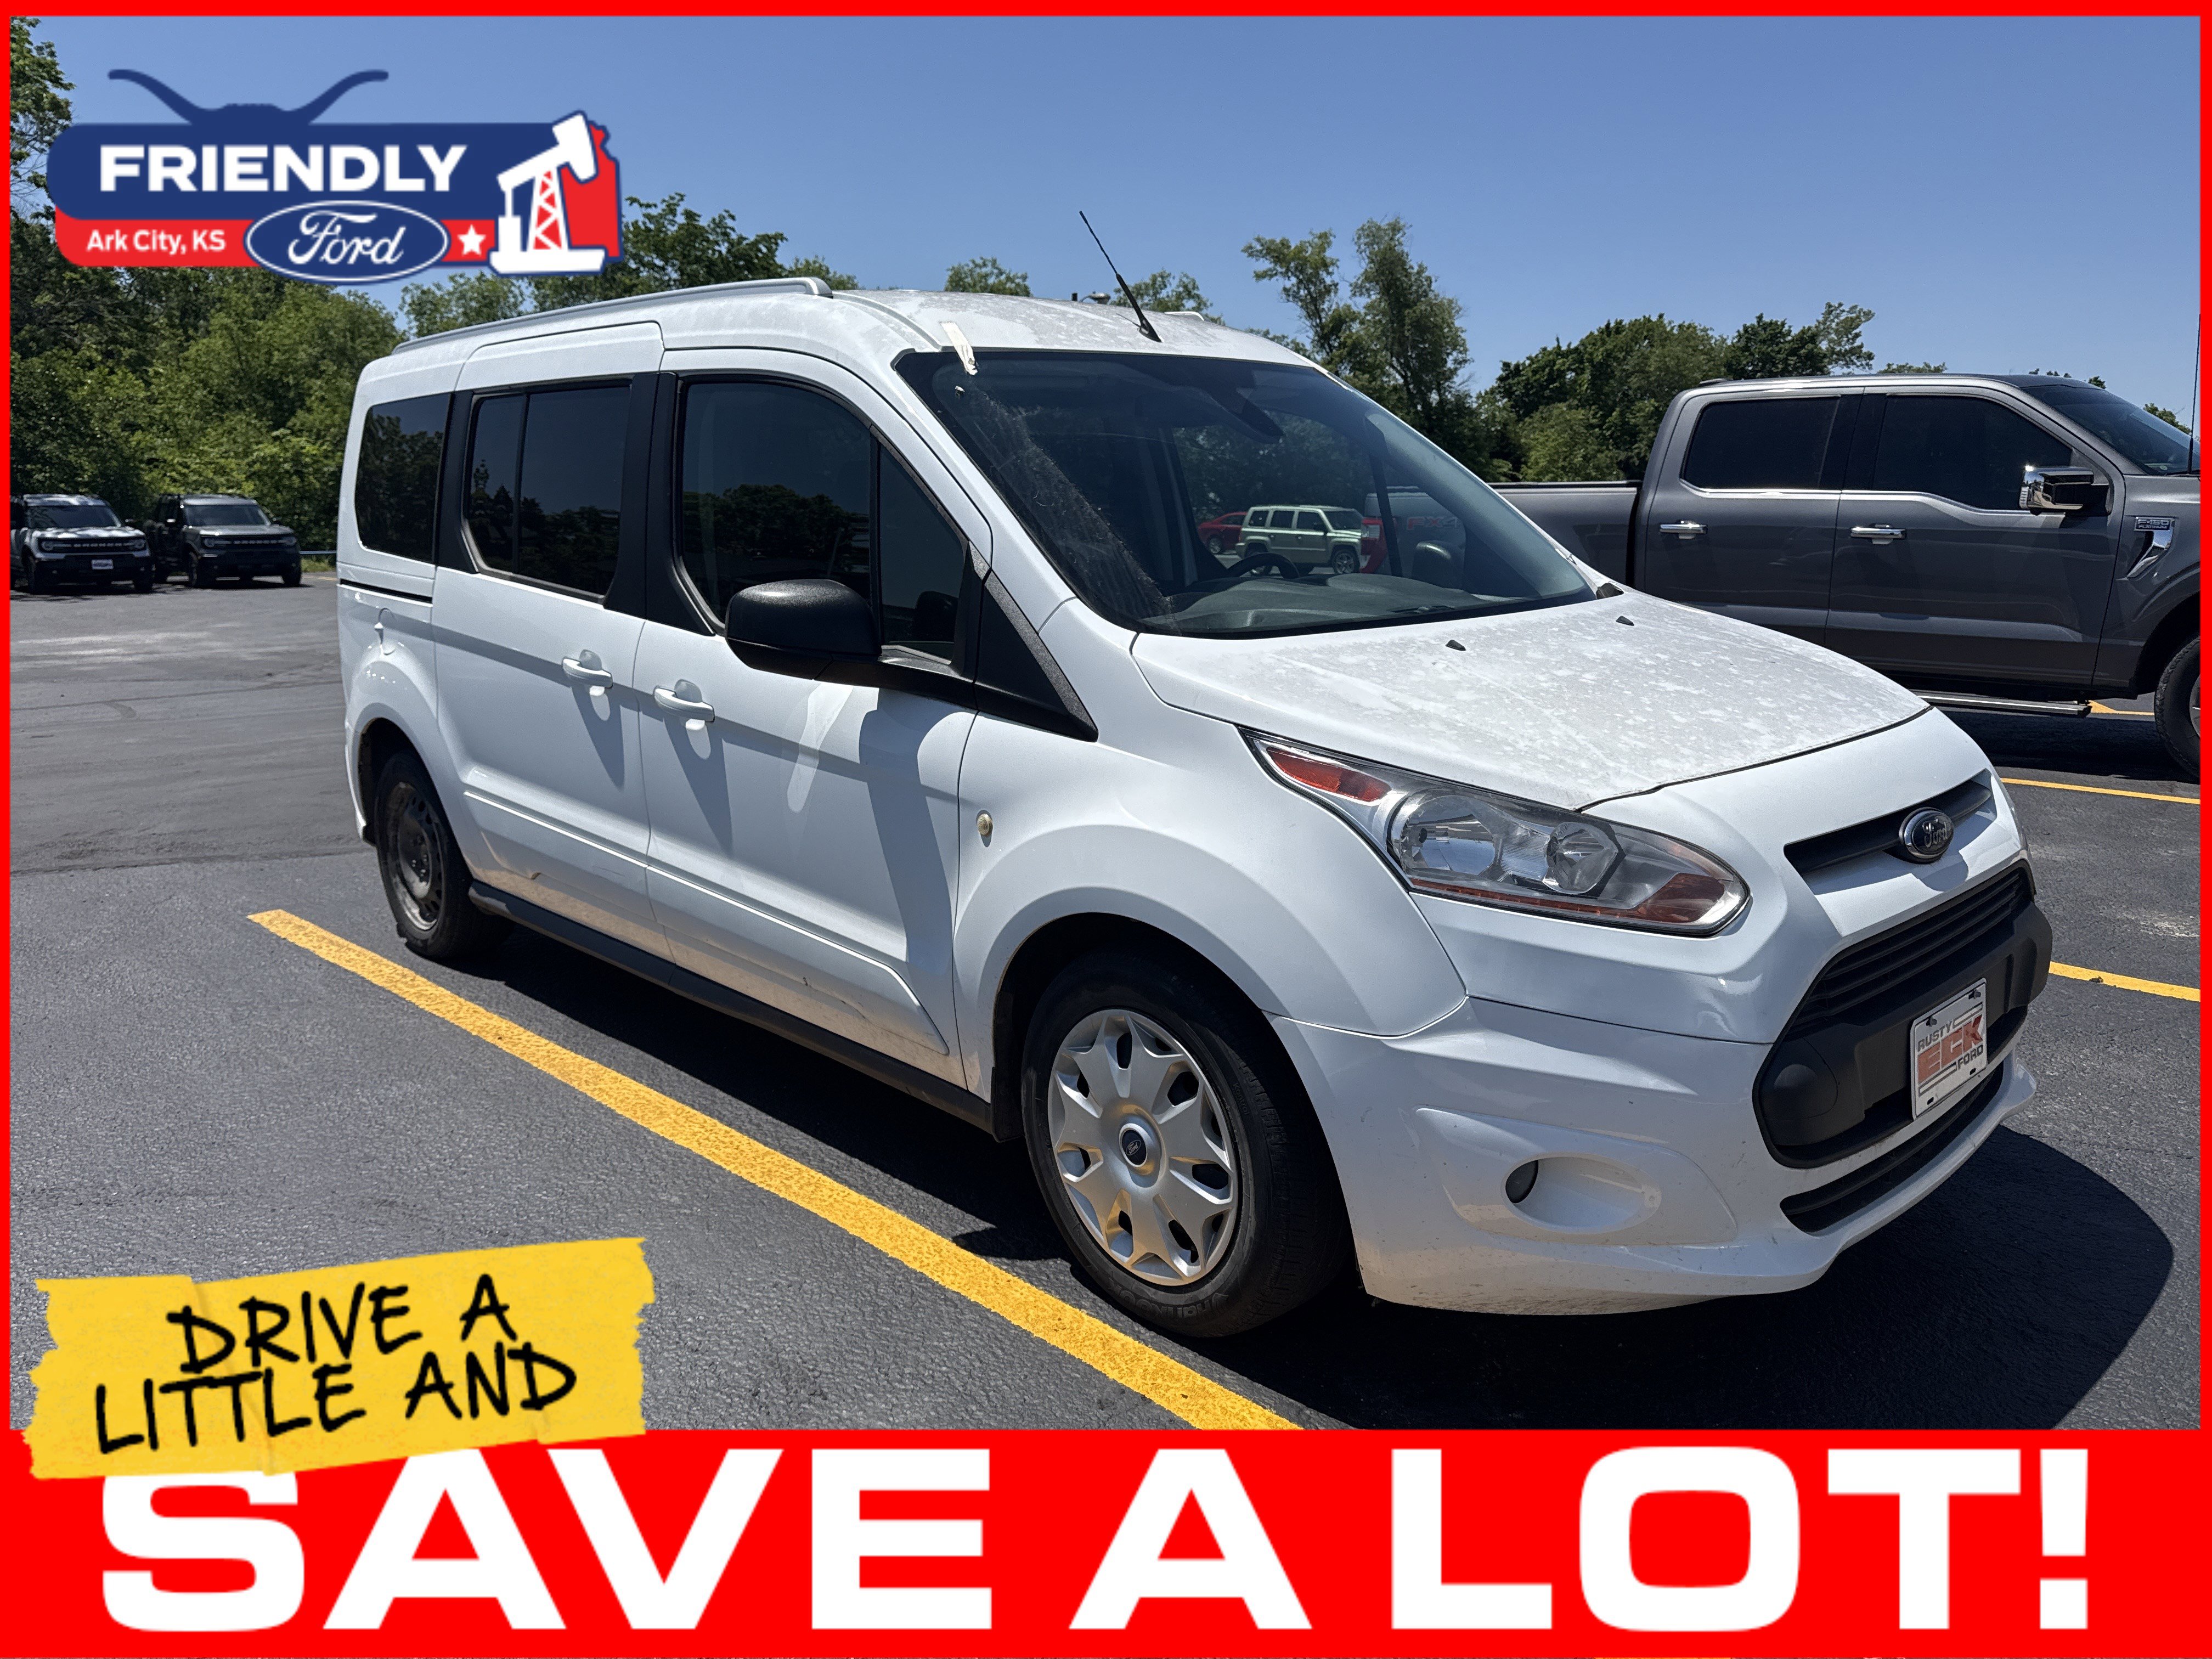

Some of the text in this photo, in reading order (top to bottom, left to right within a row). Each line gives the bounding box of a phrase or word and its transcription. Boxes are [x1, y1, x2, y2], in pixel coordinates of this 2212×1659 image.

[1407, 516, 1459, 531] FX4
[1922, 818, 1948, 848] Ford
[1917, 1020, 1953, 1052] RUSTY
[1957, 1044, 1984, 1070] FORD
